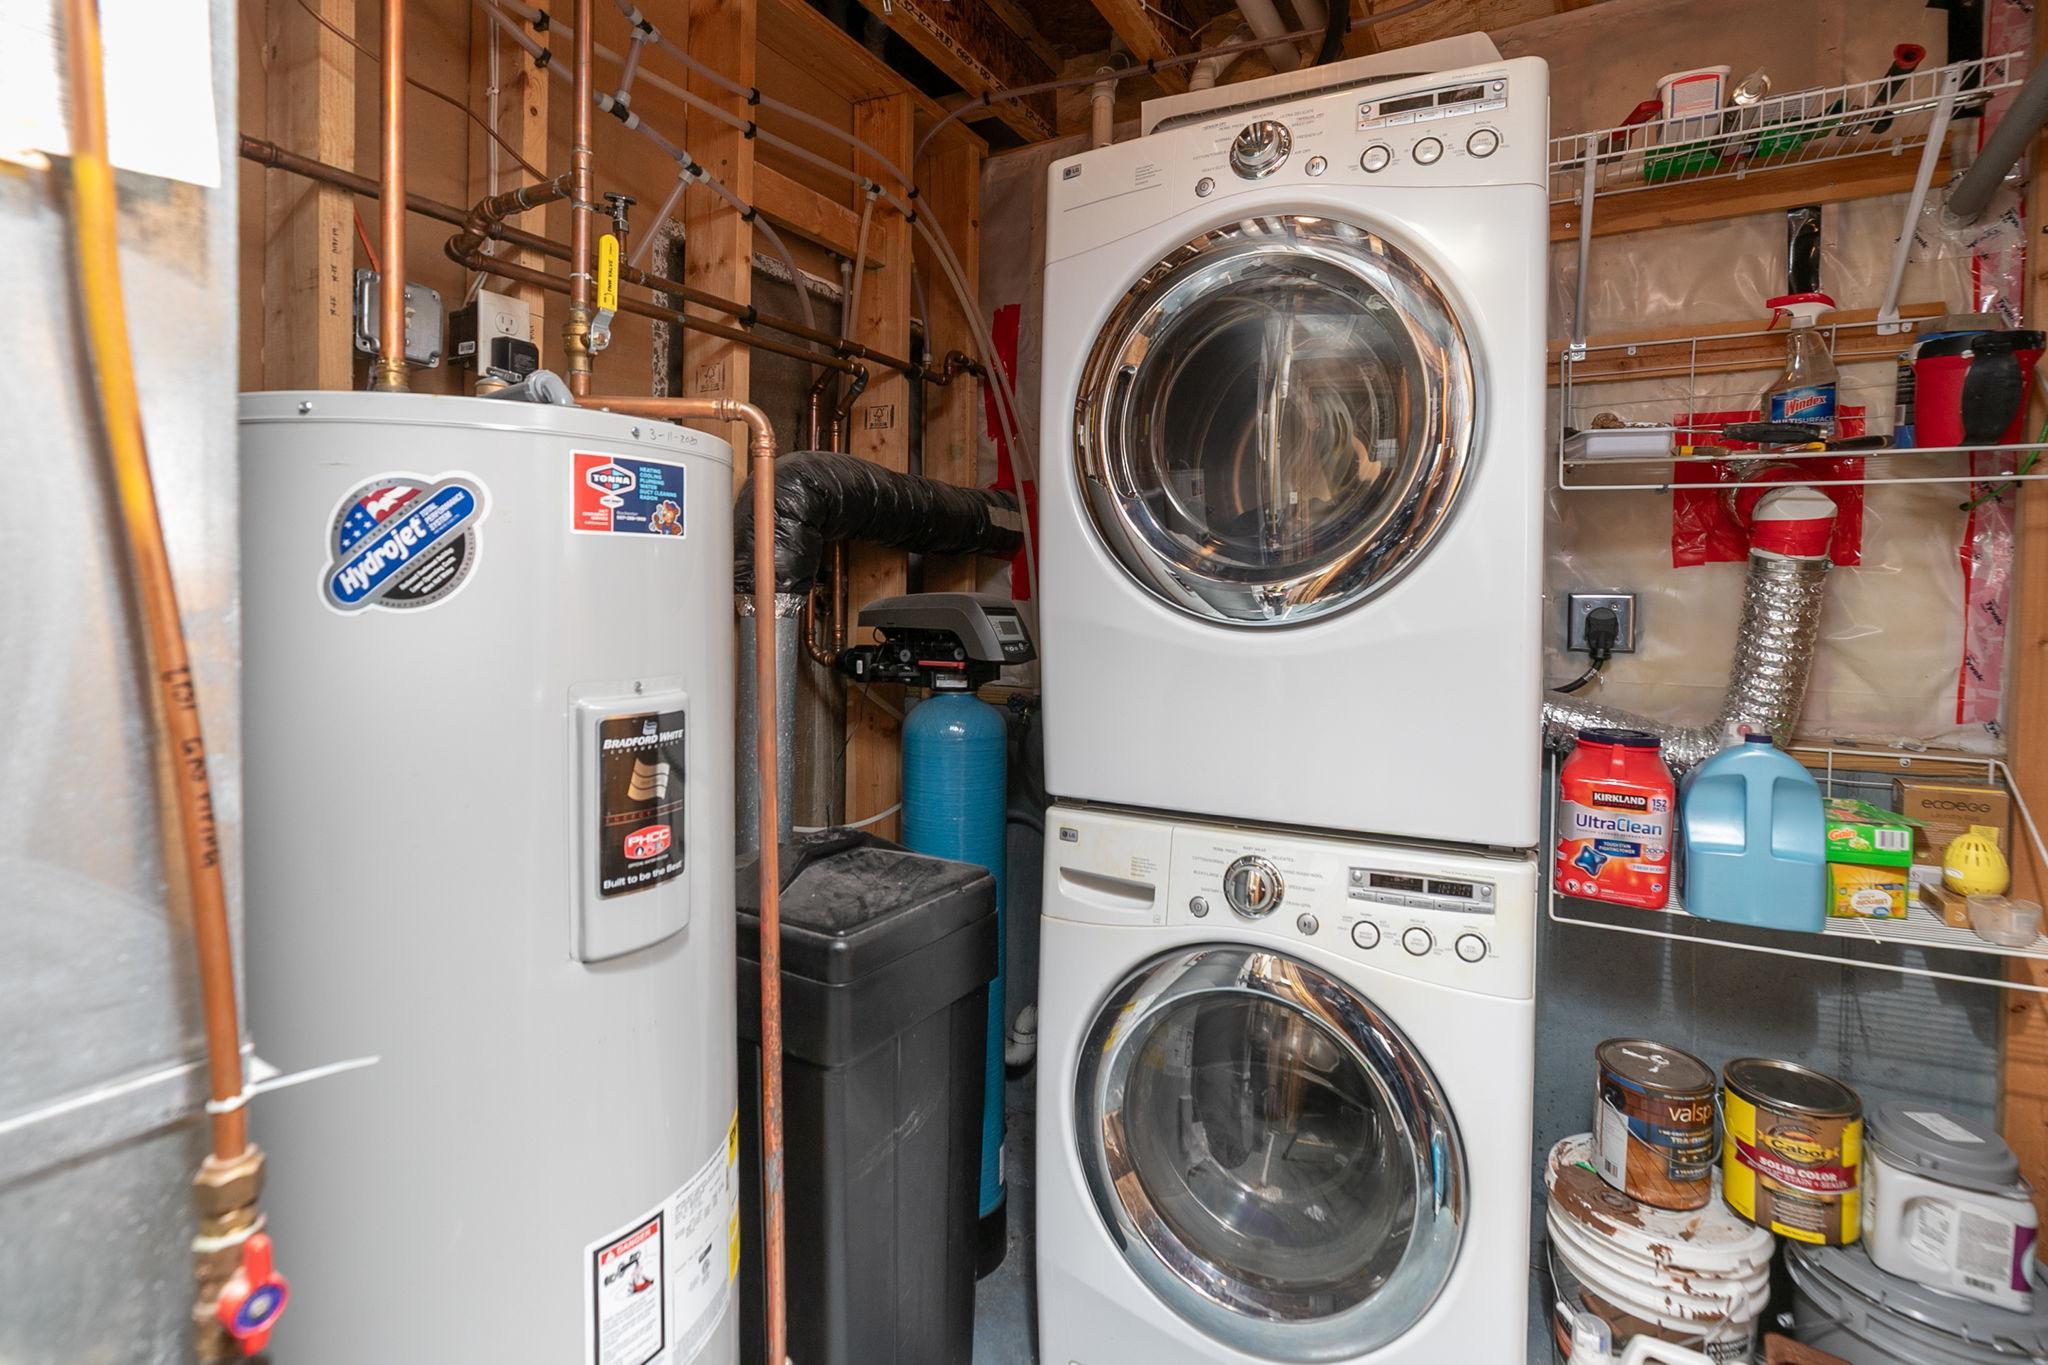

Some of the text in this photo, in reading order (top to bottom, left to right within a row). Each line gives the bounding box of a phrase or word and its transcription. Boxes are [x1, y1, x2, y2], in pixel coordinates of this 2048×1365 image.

[1784, 395, 1827, 418] Windex
[592, 474, 631, 485] TONNA
[338, 516, 427, 596] Hydrojet
[603, 729, 684, 750] BRADFORD WHITE
[1594, 792, 1646, 805] KIRKLAND
[1652, 798, 1667, 808] 152
[1576, 813, 1662, 835] UltraClean
[627, 828, 670, 848] PHCC
[1827, 828, 1857, 842] Gain
[603, 860, 683, 890] Built to be the Best
[1771, 1139, 1827, 1159] Cabot
[1760, 1156, 1838, 1182] SOLID COLOR
[617, 1228, 652, 1256] DANGER
